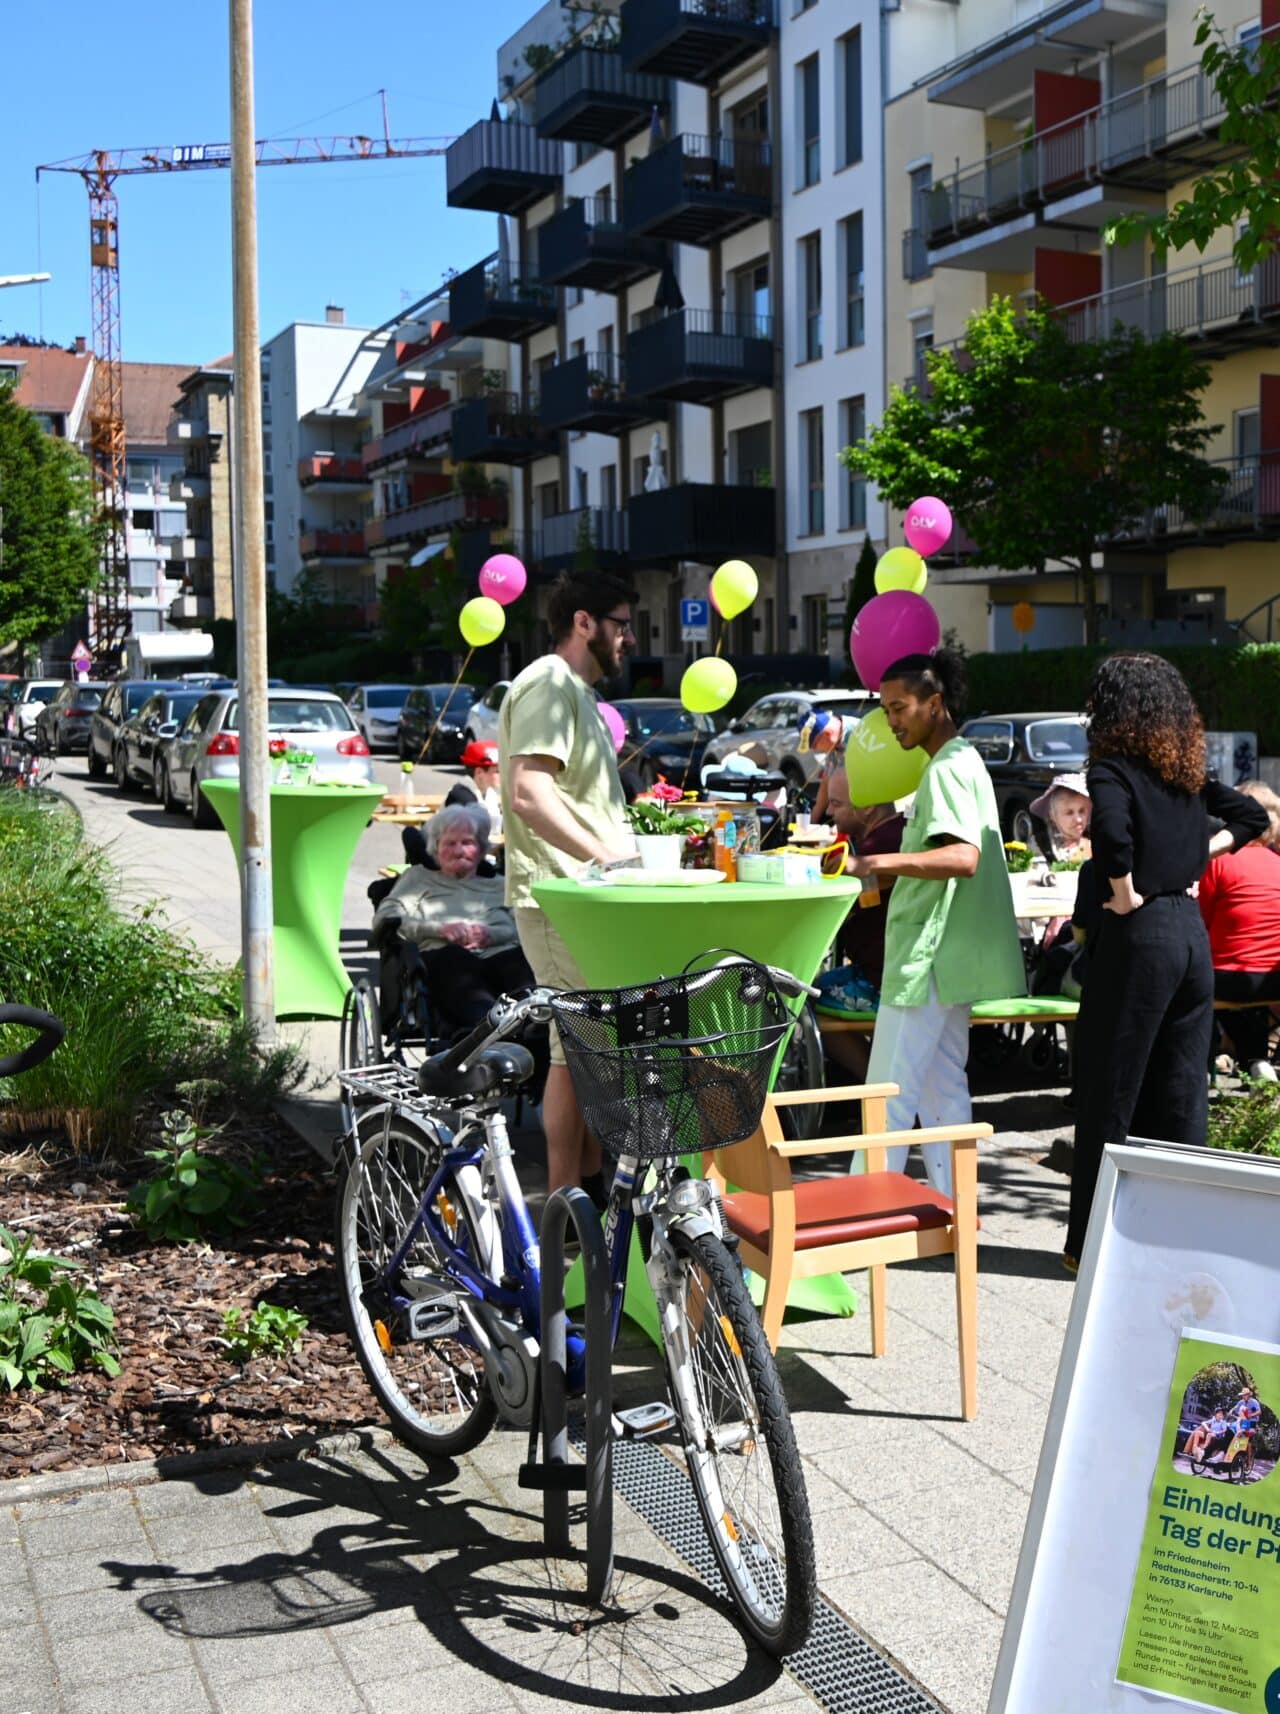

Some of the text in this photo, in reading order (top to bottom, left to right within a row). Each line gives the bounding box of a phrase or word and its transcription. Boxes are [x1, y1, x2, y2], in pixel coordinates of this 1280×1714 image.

[687, 603, 702, 623] P
[1159, 1514, 1203, 1548] Tag
[1207, 1529, 1252, 1555] der
[1152, 1560, 1259, 1593] Redtenbacherstr. 10-14
[1154, 1546, 1231, 1573] im Friedensheim
[1146, 1592, 1174, 1606] Wann?
[1149, 1573, 1233, 1601] in 76133 Karlsruhe
[1142, 1615, 1157, 1625] von
[1158, 1618, 1167, 1627] 10
[1168, 1620, 1184, 1631] Uhr
[1184, 1625, 1197, 1635] bis
[1208, 1631, 1224, 1641] Uhr
[1144, 1603, 1158, 1613] Am
[1160, 1607, 1192, 1624] Montag,
[1193, 1616, 1209, 1627] den
[1221, 1623, 1238, 1633] Mai
[1238, 1627, 1259, 1640] 2025
[1137, 1641, 1249, 1676] messen oder spielen Sie eine
[1139, 1628, 1244, 1663] Lassen Sie Ihren Blutdruck
[1133, 1661, 1252, 1699] und Erfrischungen ist gesorgt!
[1135, 1649, 1161, 1663] Runde
[1162, 1658, 1177, 1668] mit
[1185, 1663, 1197, 1673] für
[1198, 1667, 1227, 1681] leckere
[1227, 1674, 1257, 1689] Snacks
